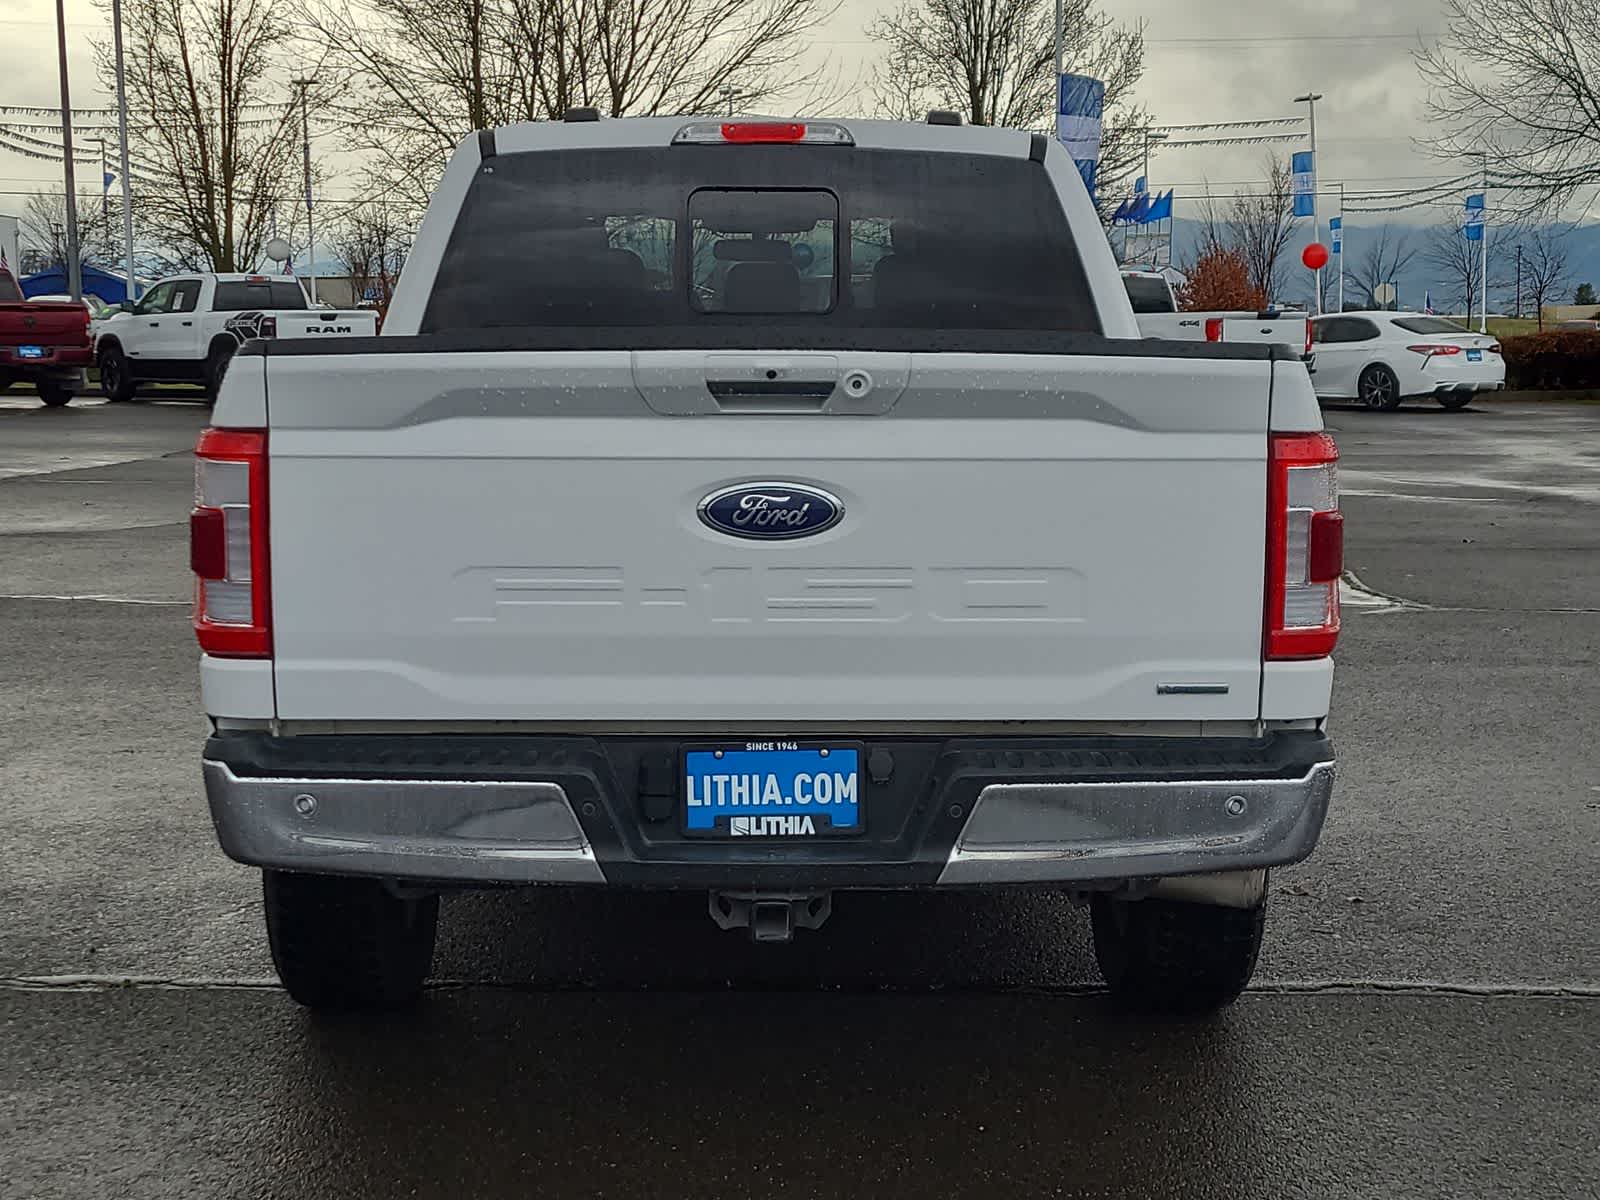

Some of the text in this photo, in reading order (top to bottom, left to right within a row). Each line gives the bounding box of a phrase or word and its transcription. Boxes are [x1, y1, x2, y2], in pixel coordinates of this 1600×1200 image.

[306, 326, 351, 334] RAM
[732, 494, 810, 526] Ford
[452, 566, 1086, 622] F-150
[777, 742, 798, 750] 1946
[687, 773, 857, 806] LITHIA.COM
[749, 816, 815, 835] LITHIA
